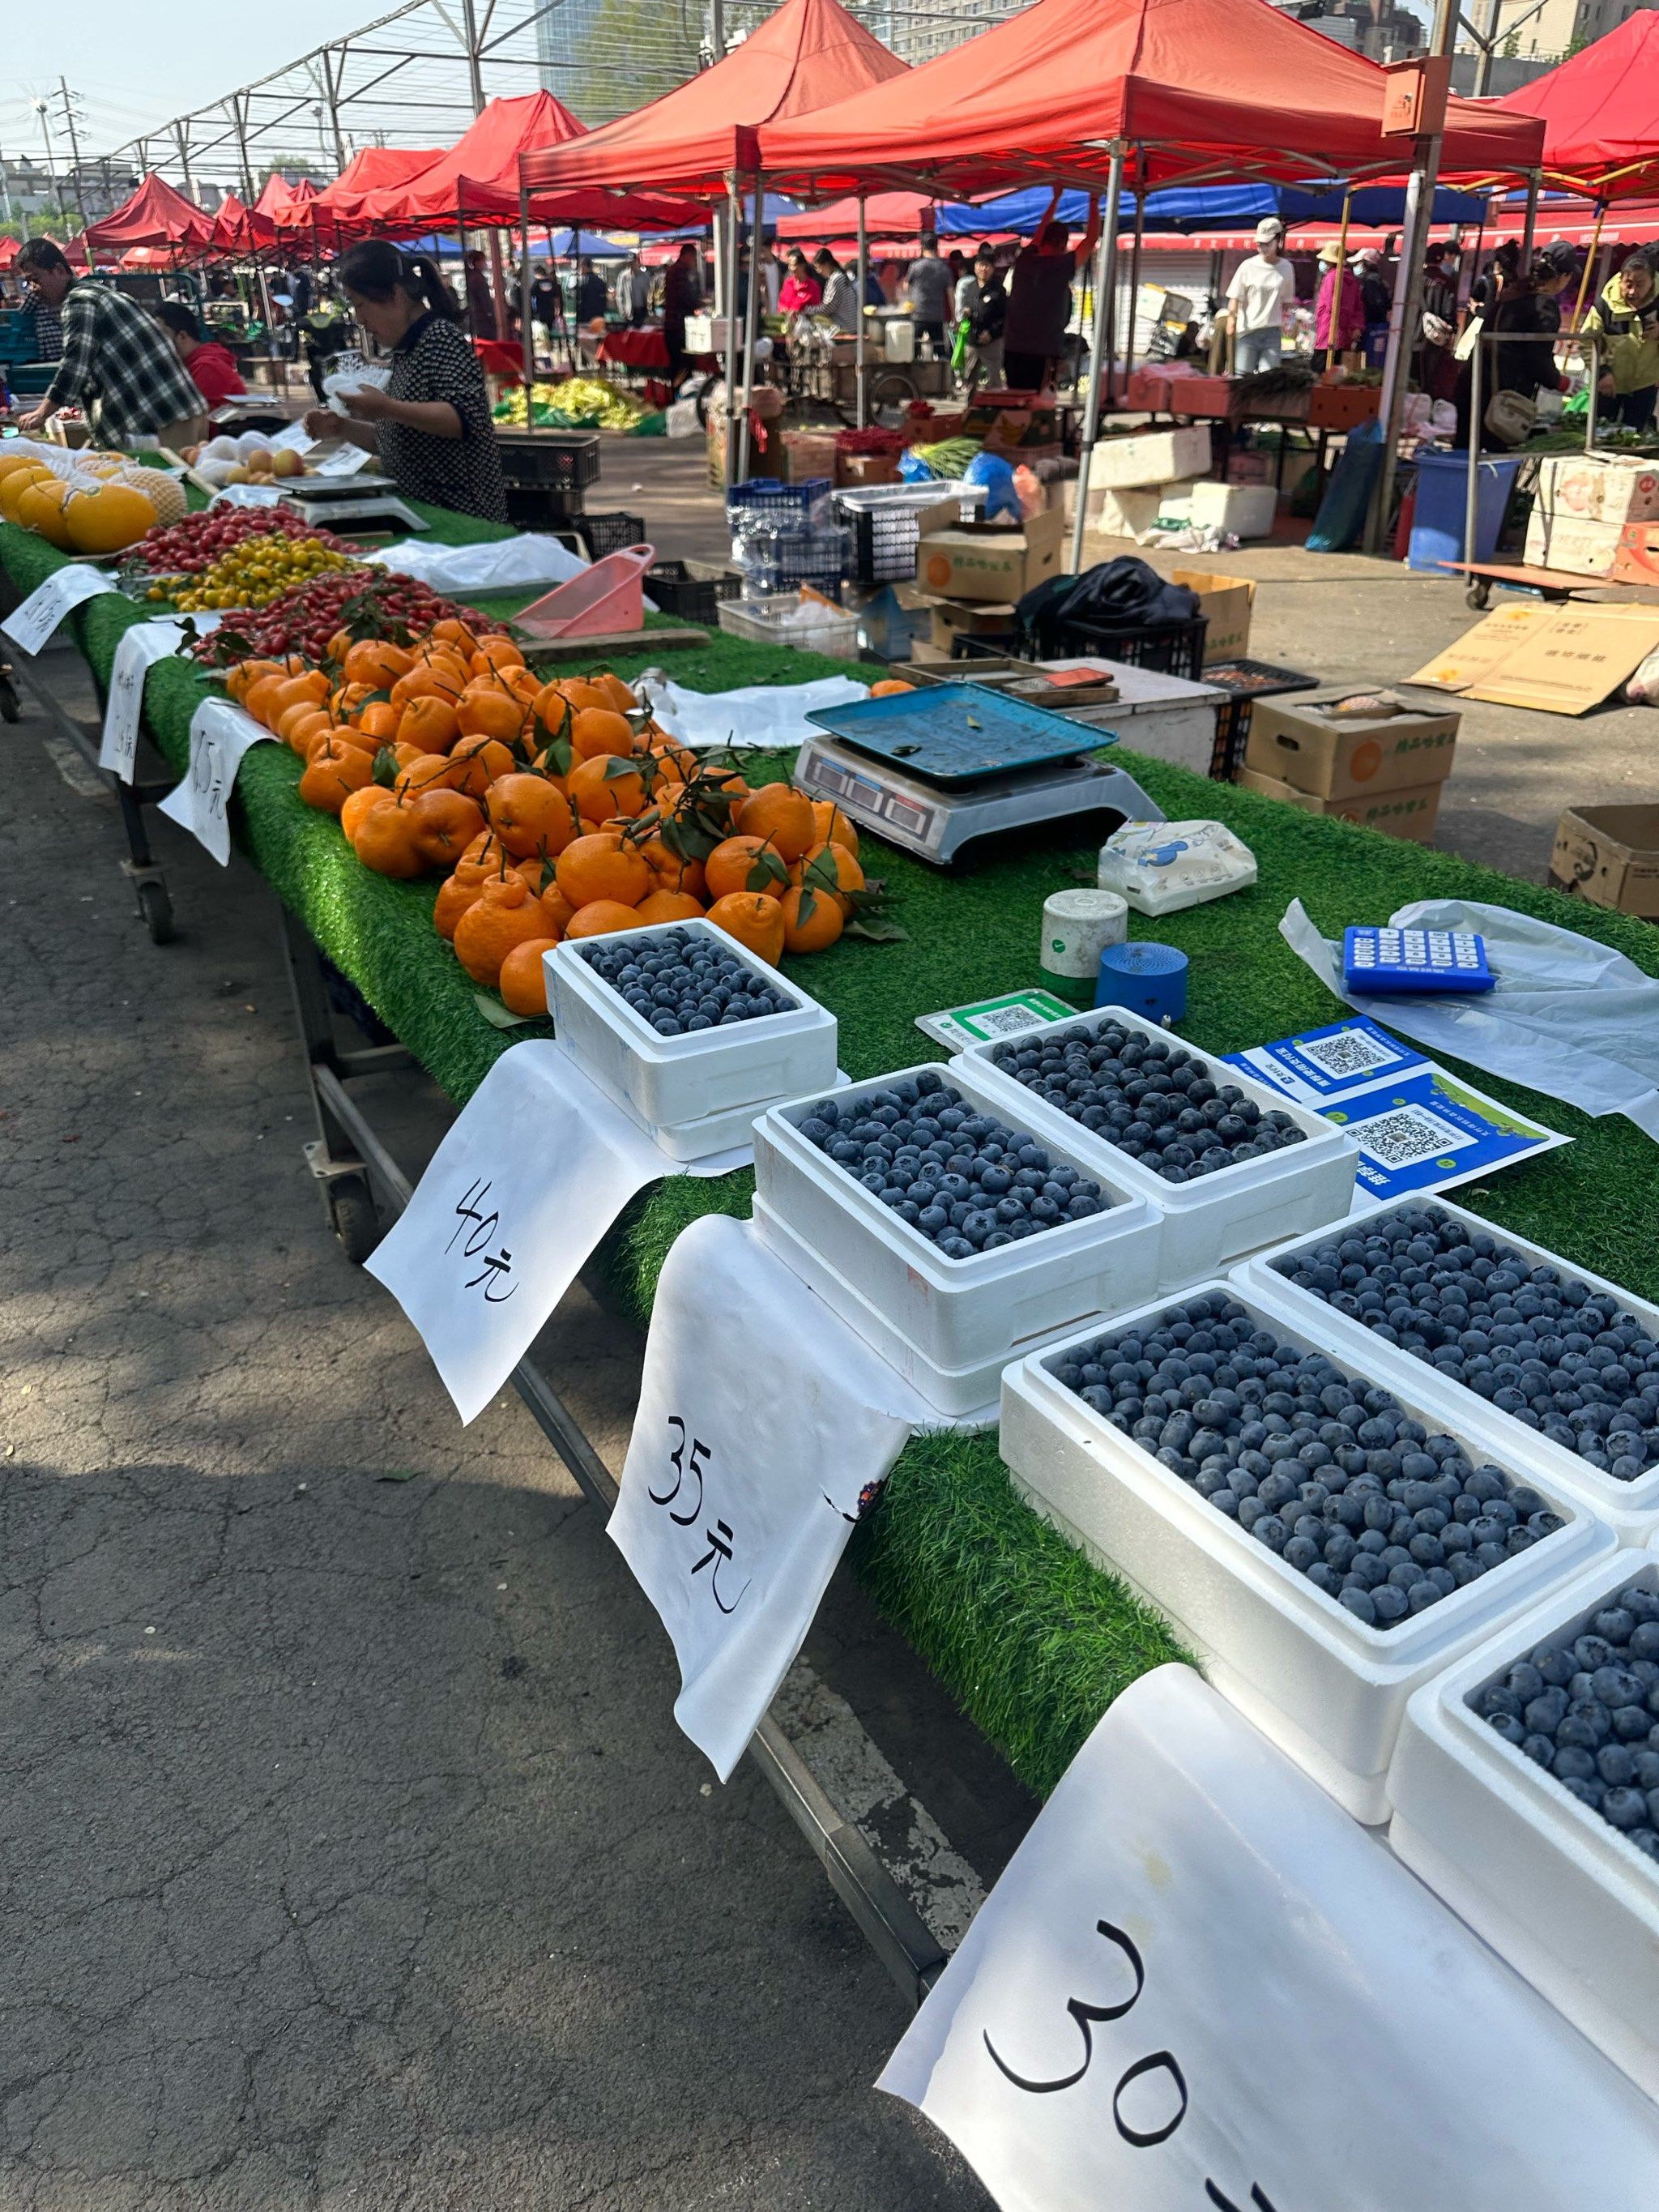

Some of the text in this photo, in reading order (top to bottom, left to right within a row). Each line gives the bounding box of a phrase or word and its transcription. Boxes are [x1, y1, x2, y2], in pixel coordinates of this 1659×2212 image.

[1275, 1047, 1332, 1087] 推荐使用支付宝
[1429, 1100, 1491, 1137] 支付得蚂蚁森林能量
[445, 1176, 519, 1303] 40元
[648, 1416, 752, 1614] 35元
[983, 1919, 1277, 2212] 30
